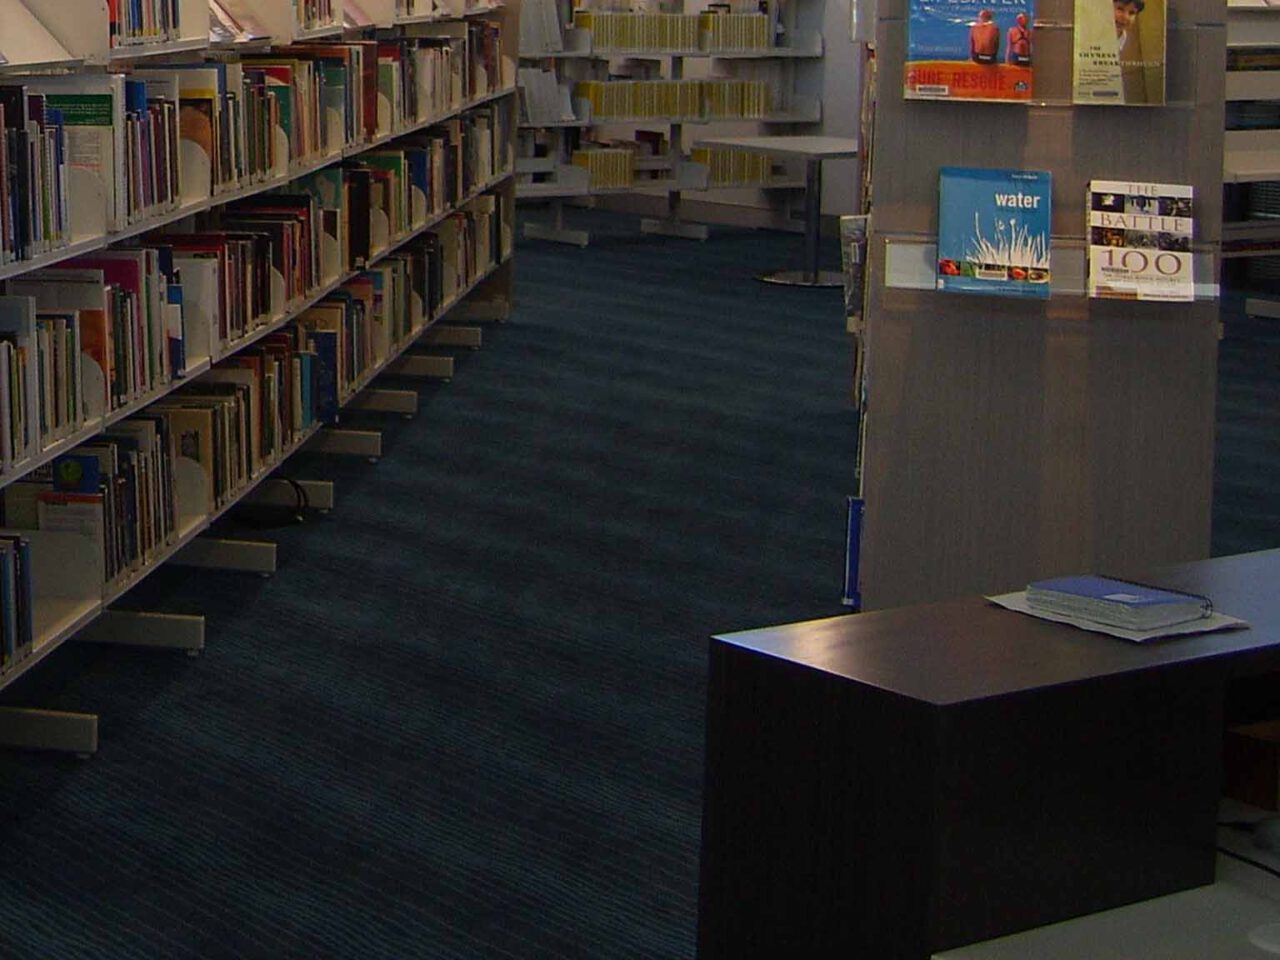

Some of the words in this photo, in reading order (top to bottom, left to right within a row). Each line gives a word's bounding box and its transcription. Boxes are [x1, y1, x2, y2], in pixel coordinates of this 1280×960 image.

[951, 69, 1006, 90] RESCUE
[1128, 184, 1158, 194] THE
[995, 191, 1041, 209] water
[1100, 213, 1184, 232] BATTLE
[1101, 249, 1182, 275] 100
